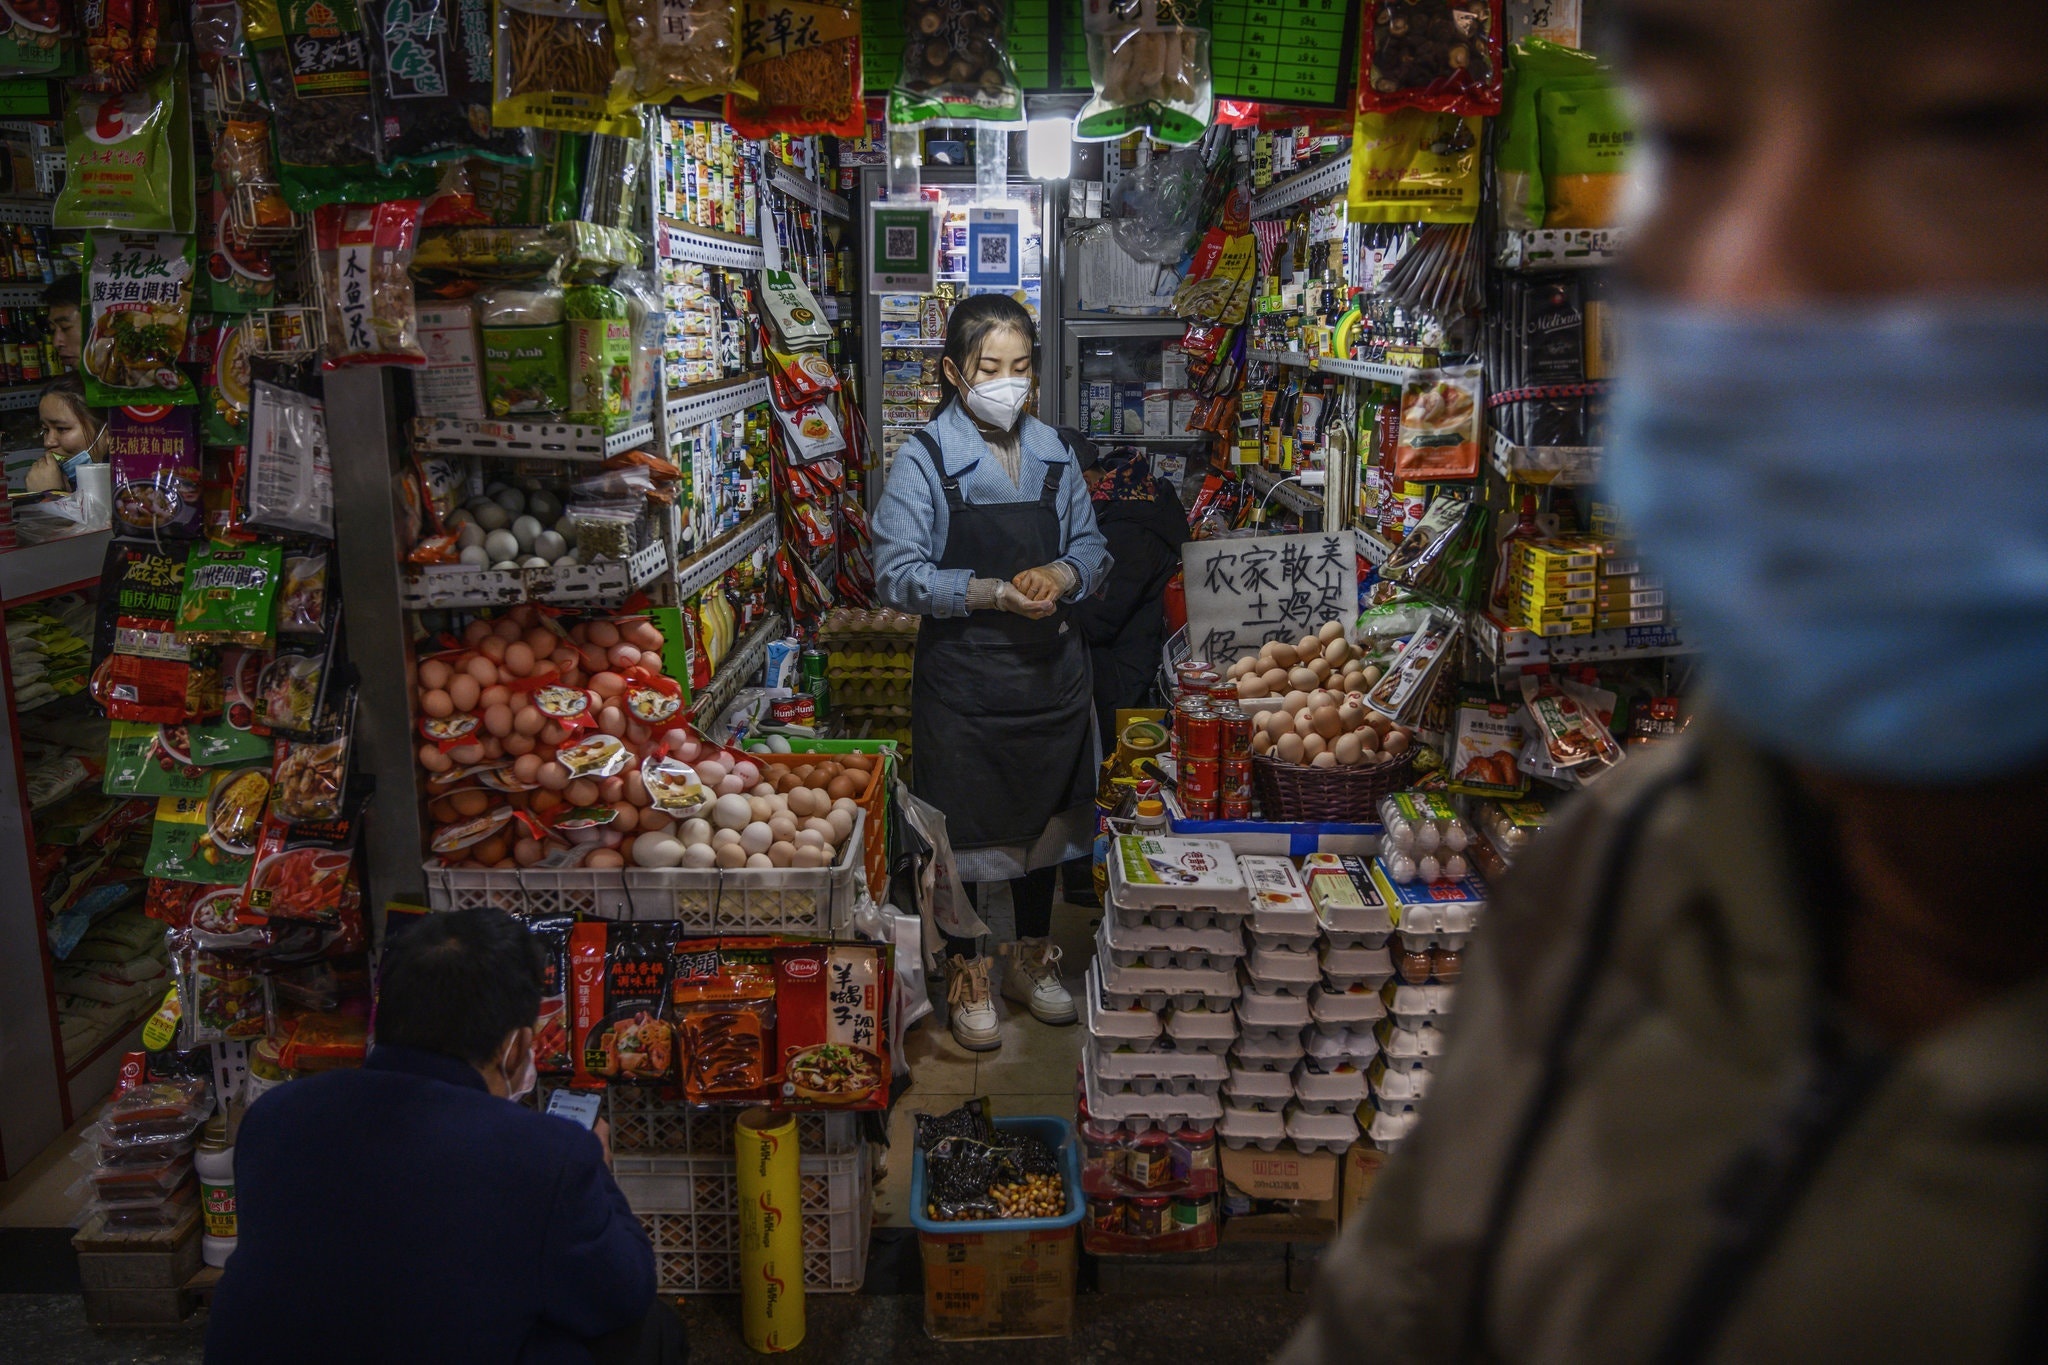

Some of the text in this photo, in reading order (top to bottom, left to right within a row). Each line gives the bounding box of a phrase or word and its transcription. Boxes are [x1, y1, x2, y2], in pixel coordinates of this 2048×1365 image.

[105, 251, 171, 279] 青花椒
[93, 281, 182, 304] 酸菜鱼调料
[343, 249, 371, 349] 木鱼花
[487, 347, 543, 360] Duy Anh
[885, 389, 917, 398] PRÉSIDENT
[1241, 587, 1348, 627] 土鸡蛋
[611, 961, 665, 975] 麻辣香锅
[617, 974, 659, 988] 调味料
